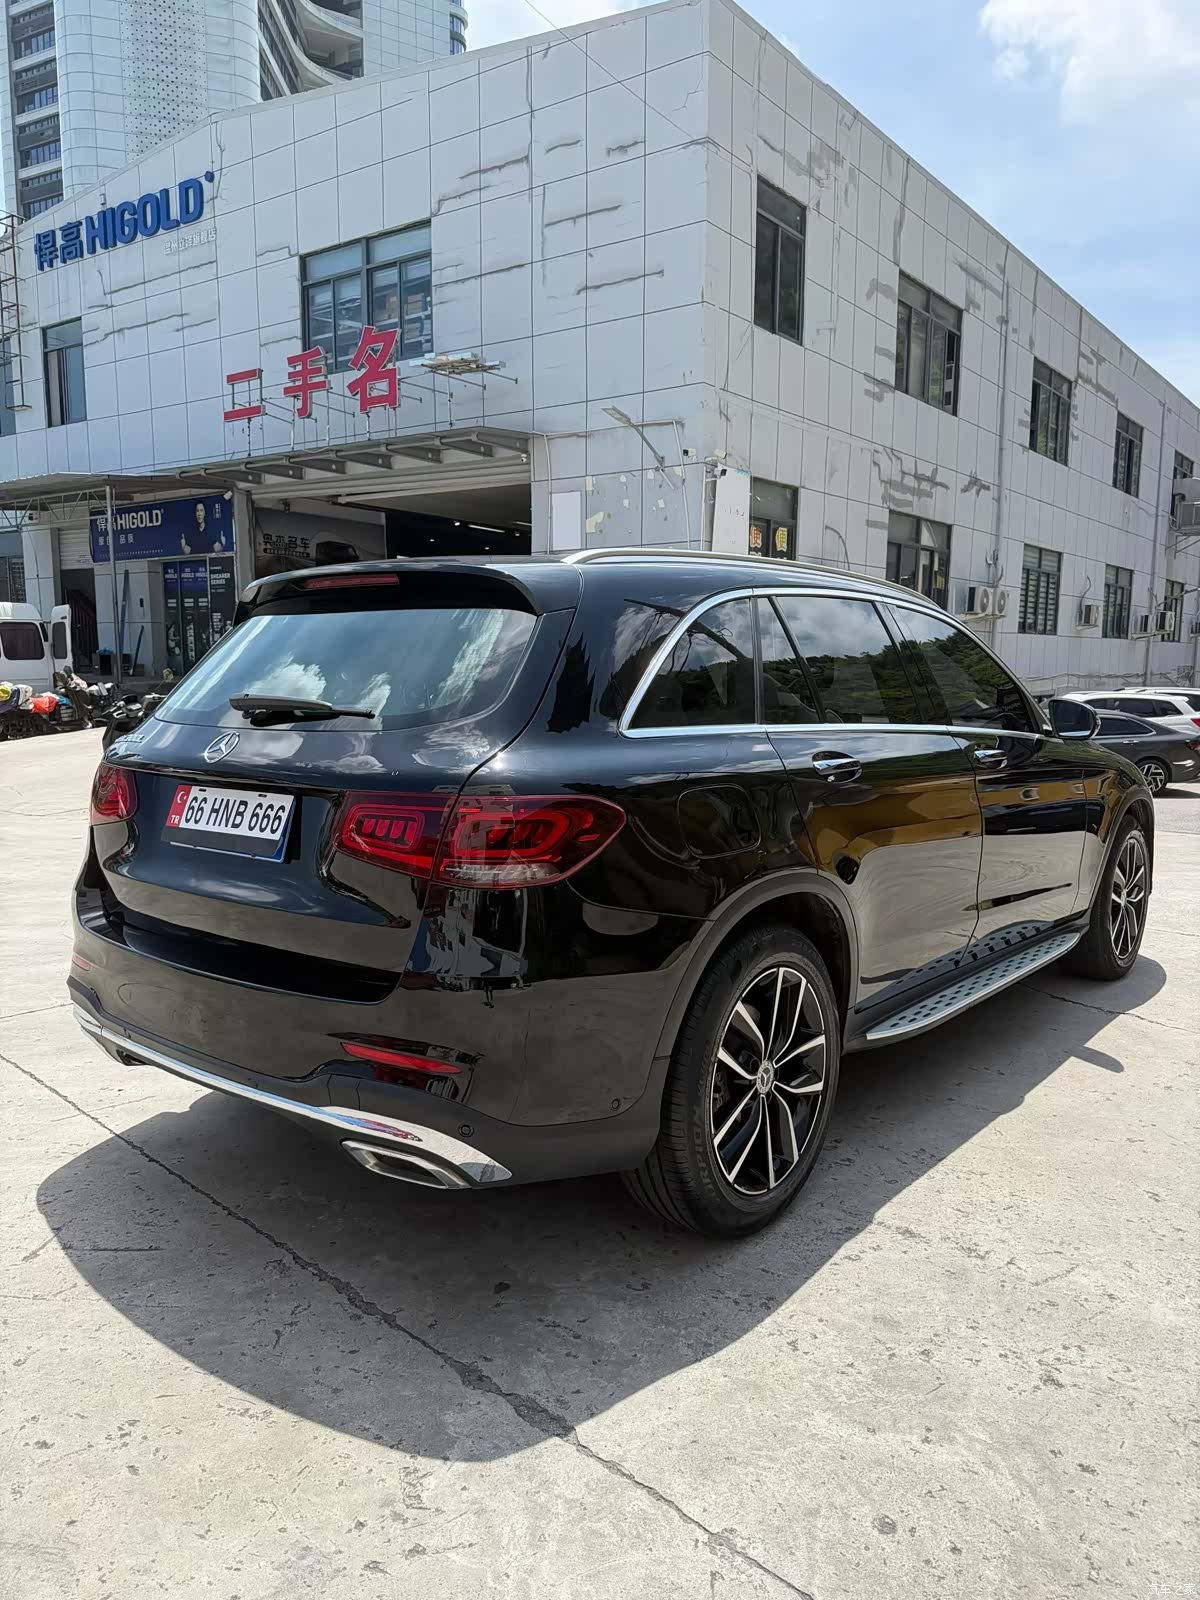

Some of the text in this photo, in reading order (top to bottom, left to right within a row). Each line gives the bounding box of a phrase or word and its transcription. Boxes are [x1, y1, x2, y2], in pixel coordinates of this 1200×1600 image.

[34, 178, 204, 271] 悍高 HIGOLD
[223, 325, 400, 422] 二手名
[116, 509, 162, 530] HIGOLD
[170, 814, 180, 825] TR
[184, 796, 286, 835] 66 HNB 666
